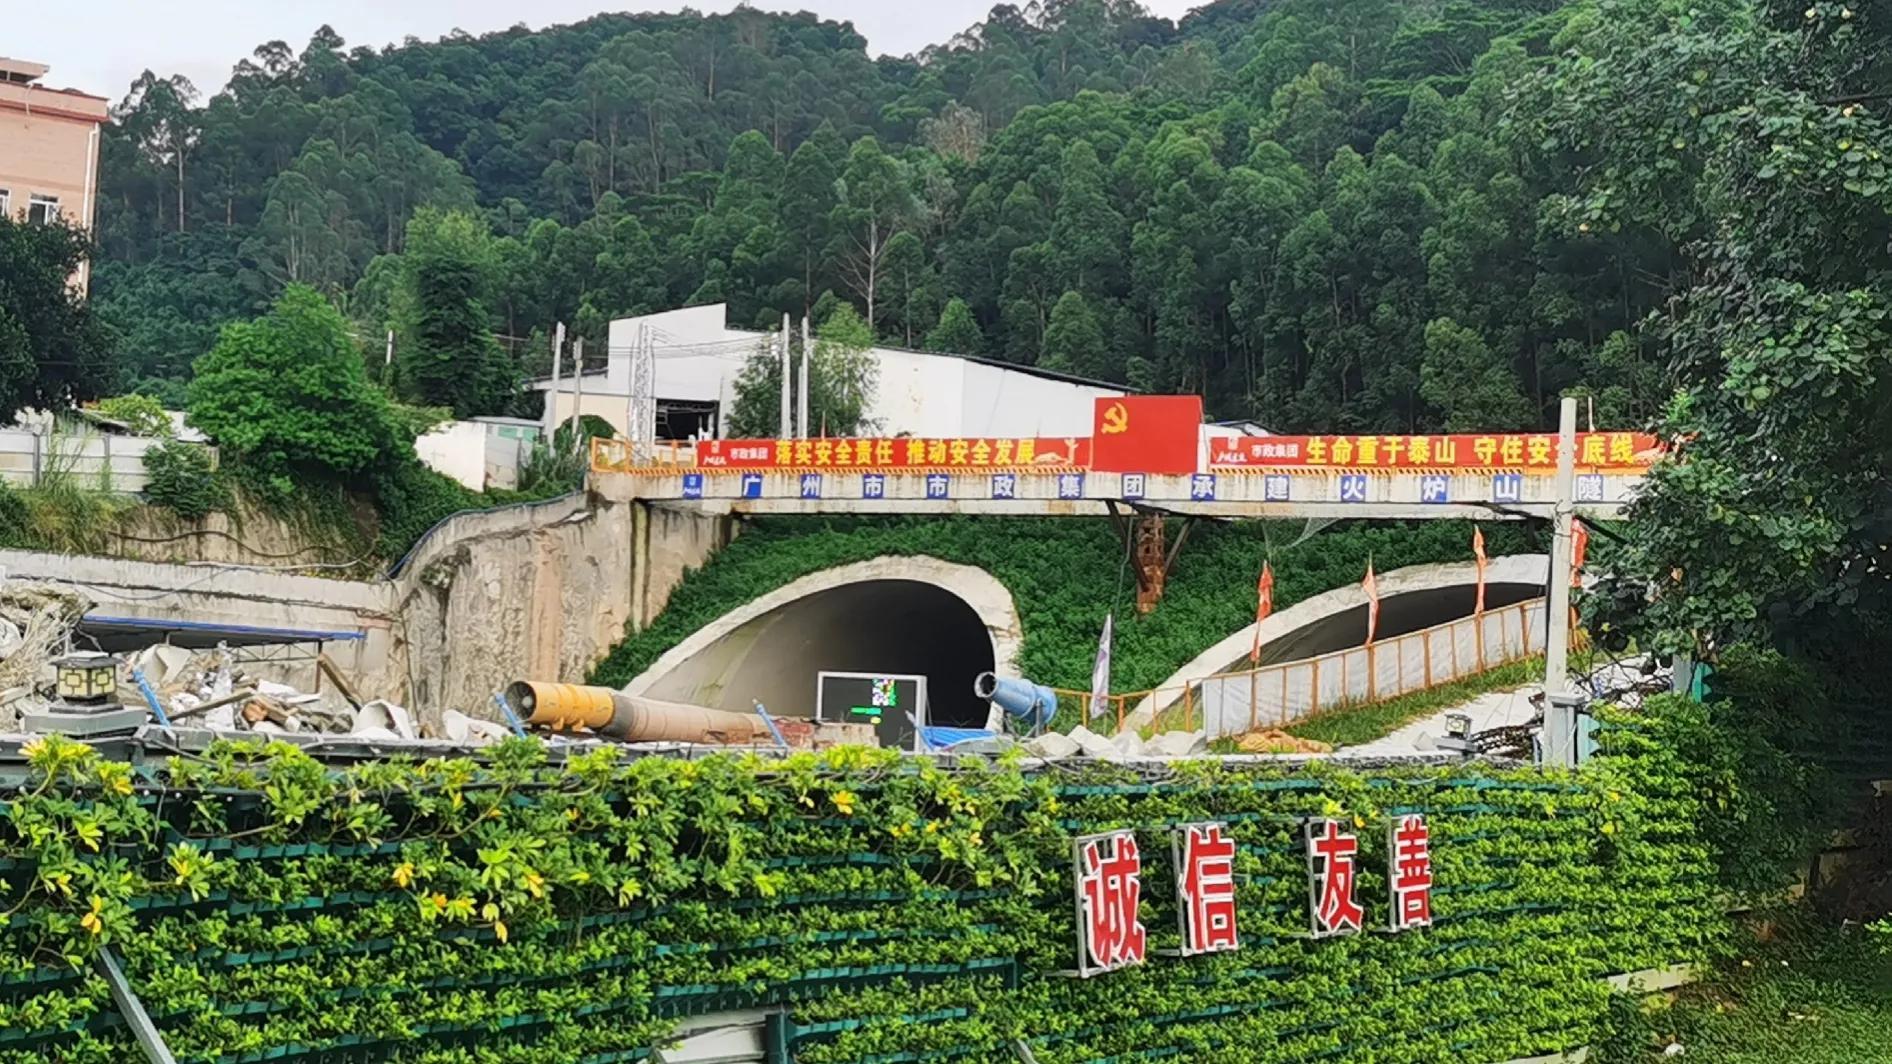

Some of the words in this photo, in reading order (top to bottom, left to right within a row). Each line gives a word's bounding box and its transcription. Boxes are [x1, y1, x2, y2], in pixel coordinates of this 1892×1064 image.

[775, 439, 894, 465] 落实安全责任
[906, 438, 1035, 465] 推动安全发展
[1251, 443, 1299, 459] 市政集团
[1306, 436, 1456, 464] 生命重于泰山
[1474, 434, 1634, 464] 守住安底线
[1084, 824, 1239, 968] 诚信
[1314, 814, 1433, 932] 友善
